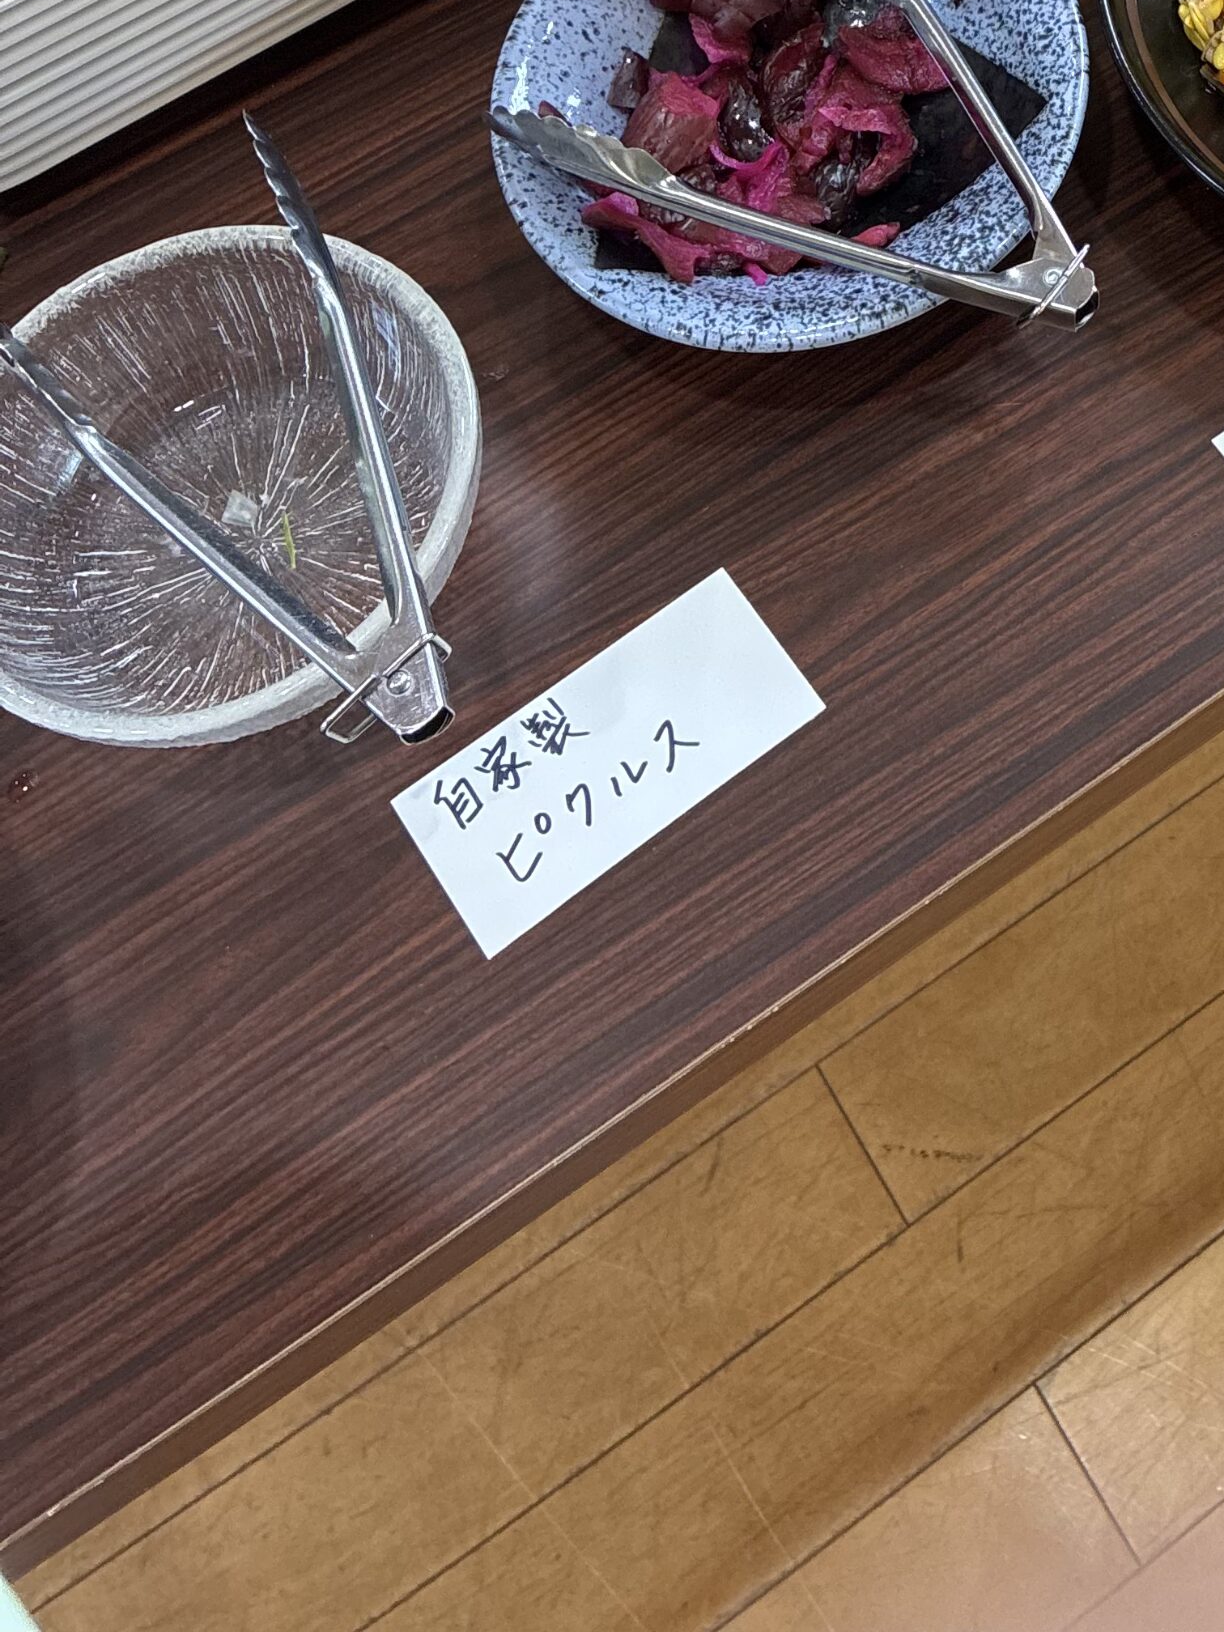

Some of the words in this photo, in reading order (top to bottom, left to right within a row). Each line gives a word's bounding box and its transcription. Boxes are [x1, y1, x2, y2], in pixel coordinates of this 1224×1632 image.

[433, 697, 591, 830] 自家製
[496, 719, 701, 883] ピクルス
